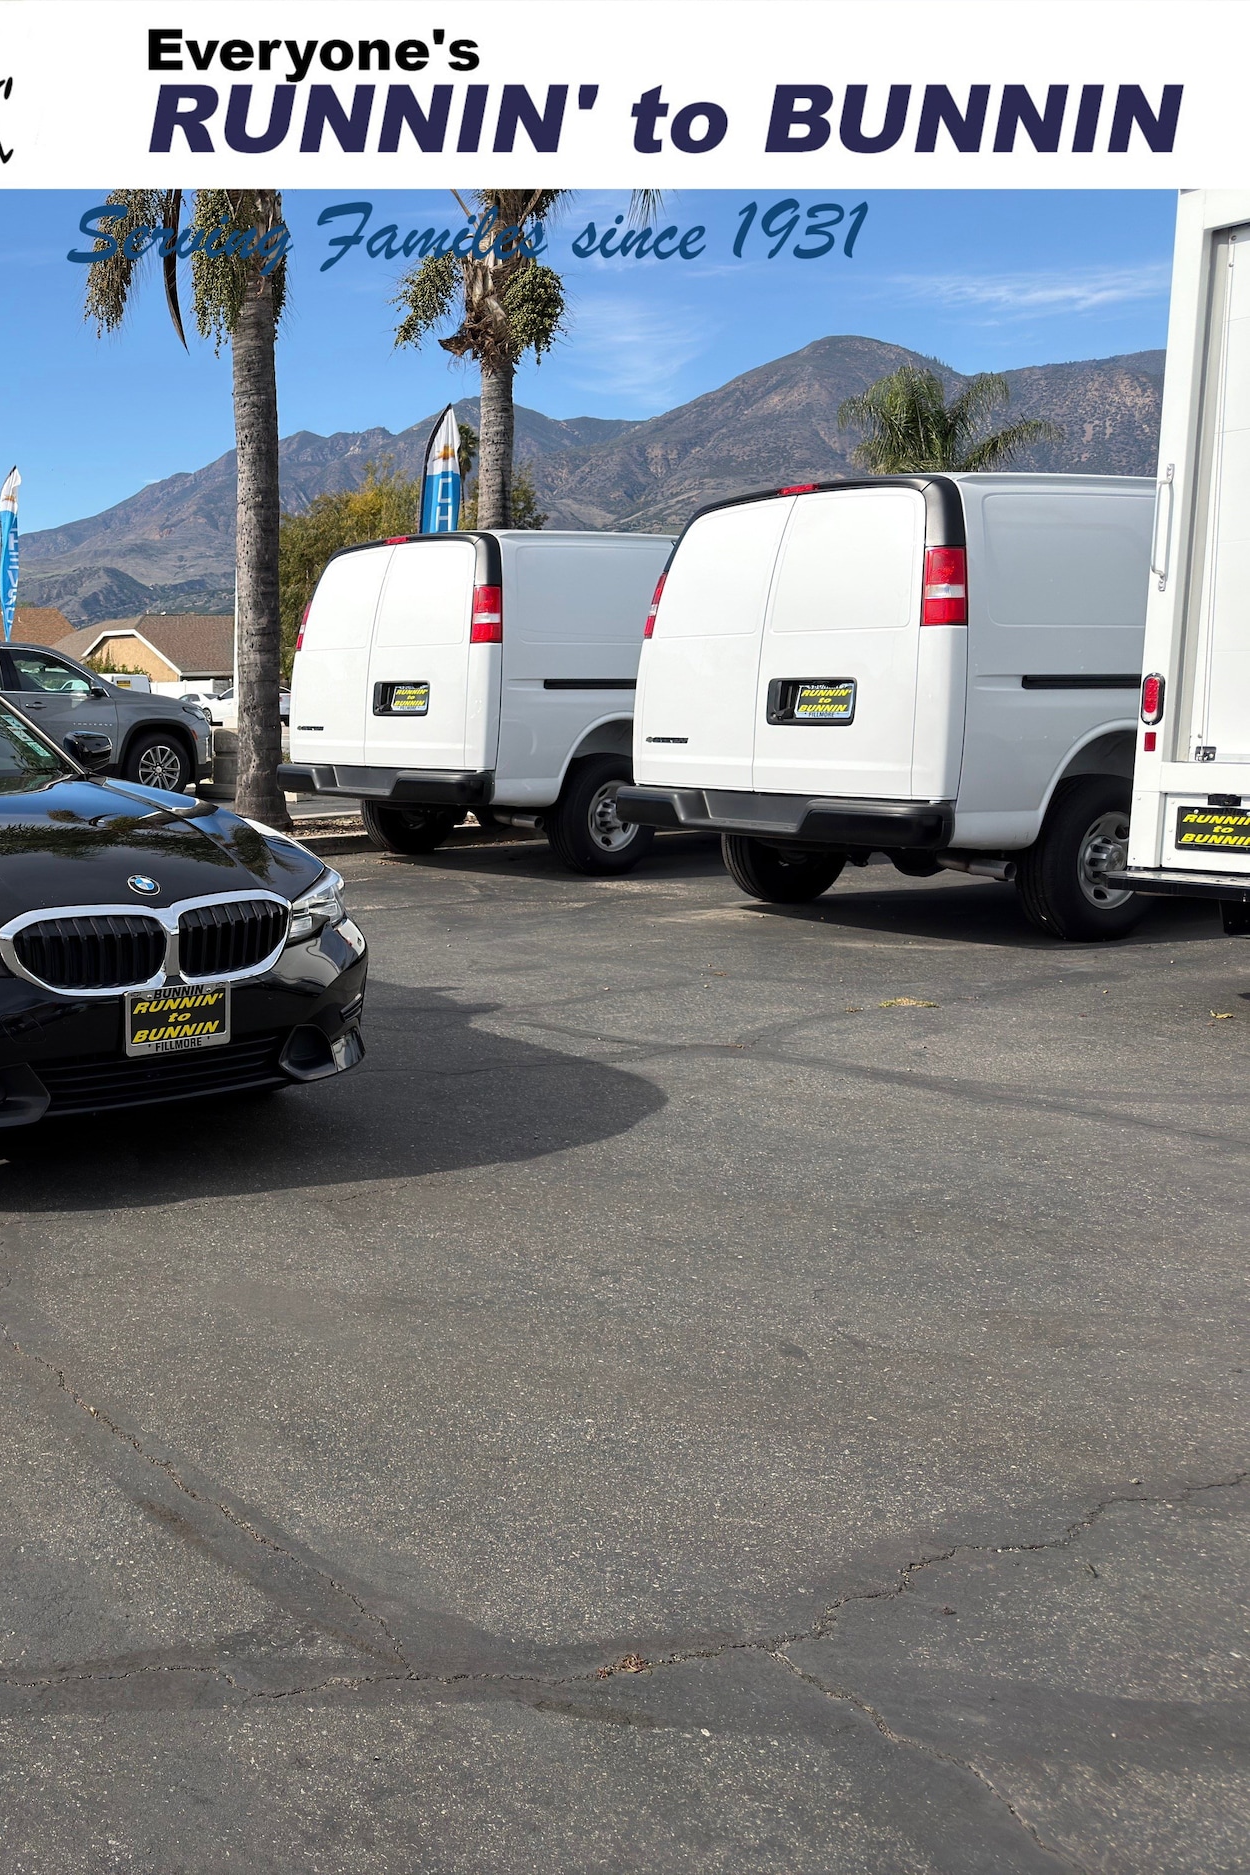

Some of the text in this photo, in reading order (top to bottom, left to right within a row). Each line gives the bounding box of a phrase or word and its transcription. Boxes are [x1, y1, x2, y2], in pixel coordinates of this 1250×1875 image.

[798, 704, 847, 712] BUNNIN
[1212, 825, 1234, 833] to
[154, 985, 204, 1000] BUNNIN
[133, 993, 224, 1015] RUNNIN'
[168, 1012, 191, 1023] to
[131, 1020, 220, 1043] BUNNIN
[155, 1037, 202, 1052] FILLMORE
